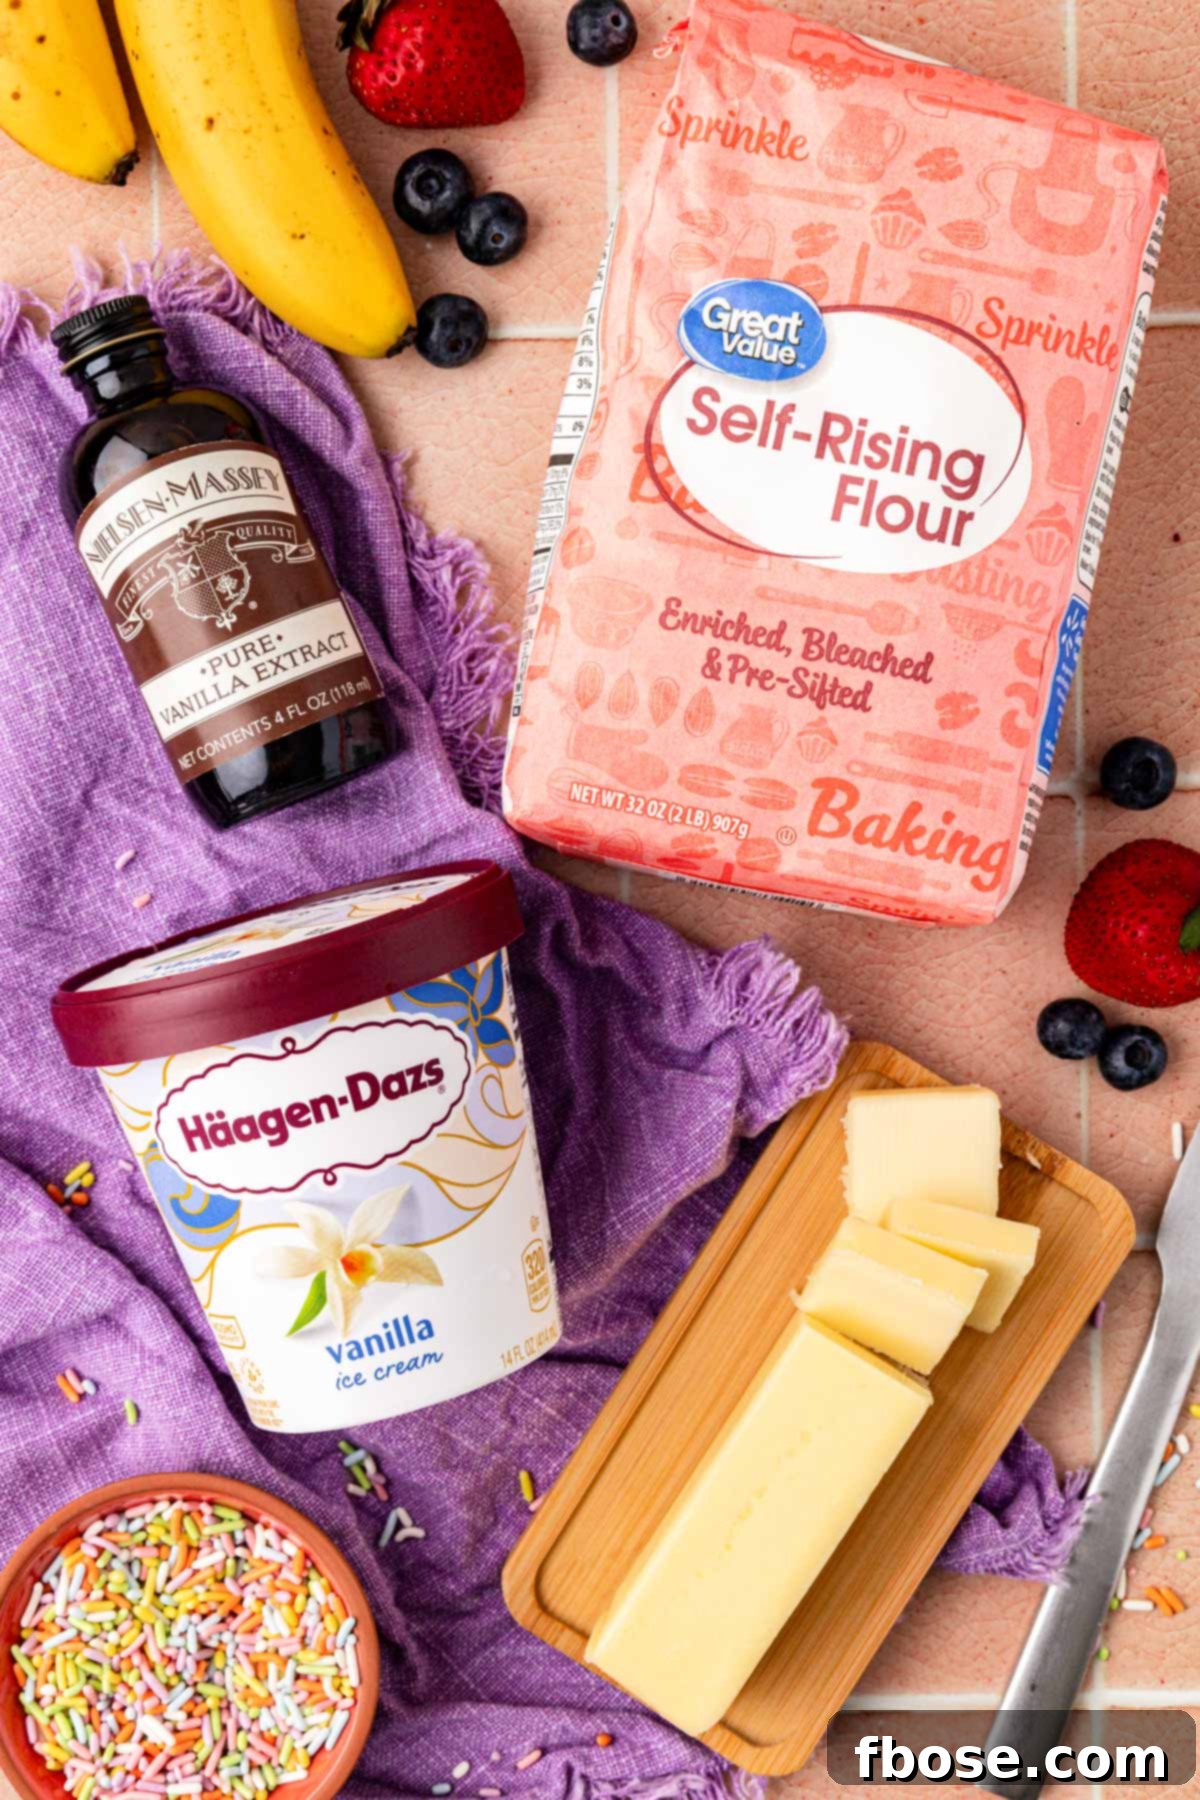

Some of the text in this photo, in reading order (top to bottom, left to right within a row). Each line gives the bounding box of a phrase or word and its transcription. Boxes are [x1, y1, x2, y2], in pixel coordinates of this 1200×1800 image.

[658, 96, 809, 161] Sprinkle
[702, 296, 803, 344] Great
[722, 331, 797, 365] Value
[975, 296, 1118, 372] Sprinkle
[577, 378, 592, 390] 3%
[686, 385, 986, 501] Self-Rising
[236, 524, 293, 541] QUALITY
[830, 474, 974, 547] Flour
[122, 565, 156, 609] FINEST
[658, 597, 934, 683] Enriched, Bleached
[160, 631, 349, 725] VANILLA EXTRACT
[701, 647, 873, 713] & Pre-Sifted
[178, 751, 198, 771] NET
[197, 718, 272, 760] CONTENTS
[274, 711, 285, 725] 4
[287, 704, 307, 720] FL
[307, 692, 330, 710] OZ
[330, 682, 356, 704] (118
[570, 783, 749, 840] NET WT 32 OZ (2 LB) 907g
[807, 777, 1011, 892] Baking
[177, 1058, 445, 1153] Häagen-Dazs
[525, 1246, 545, 1280] 320
[326, 1314, 435, 1365] vanilla
[500, 1349, 513, 1368] 14
[336, 1352, 444, 1391] ice cream
